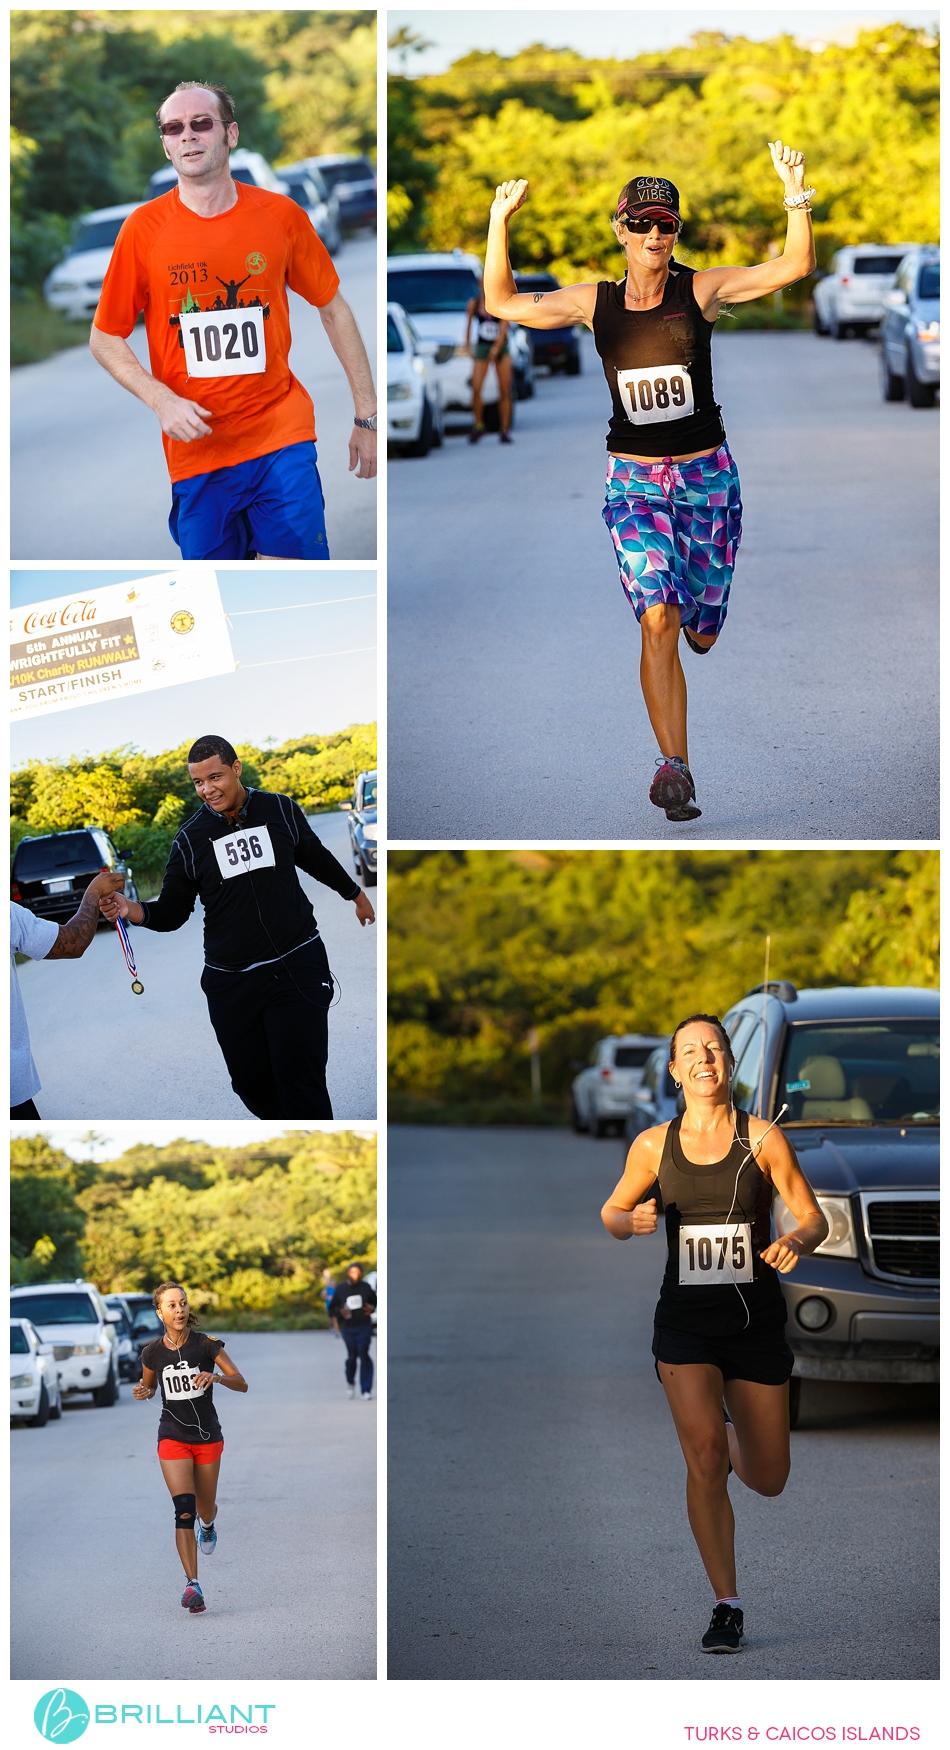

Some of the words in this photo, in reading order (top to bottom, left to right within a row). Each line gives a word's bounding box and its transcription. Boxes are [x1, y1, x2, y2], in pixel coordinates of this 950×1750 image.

[637, 188, 673, 204] VIBES
[167, 262, 195, 271] Lichfield
[169, 268, 208, 286] 2013
[189, 320, 259, 362] 1020
[625, 375, 686, 413] 1089
[10, 640, 99, 672] WRIGHTFULLY
[100, 635, 122, 650] FIT
[25, 641, 47, 654] 5th
[51, 628, 102, 649] ANNUAL
[36, 663, 76, 681] Charity
[76, 647, 138, 671] RUN/WALK
[18, 669, 123, 702] START/FINISH
[59, 692, 82, 701] PROVO
[224, 835, 263, 866] 536
[685, 1236, 746, 1271] 1075
